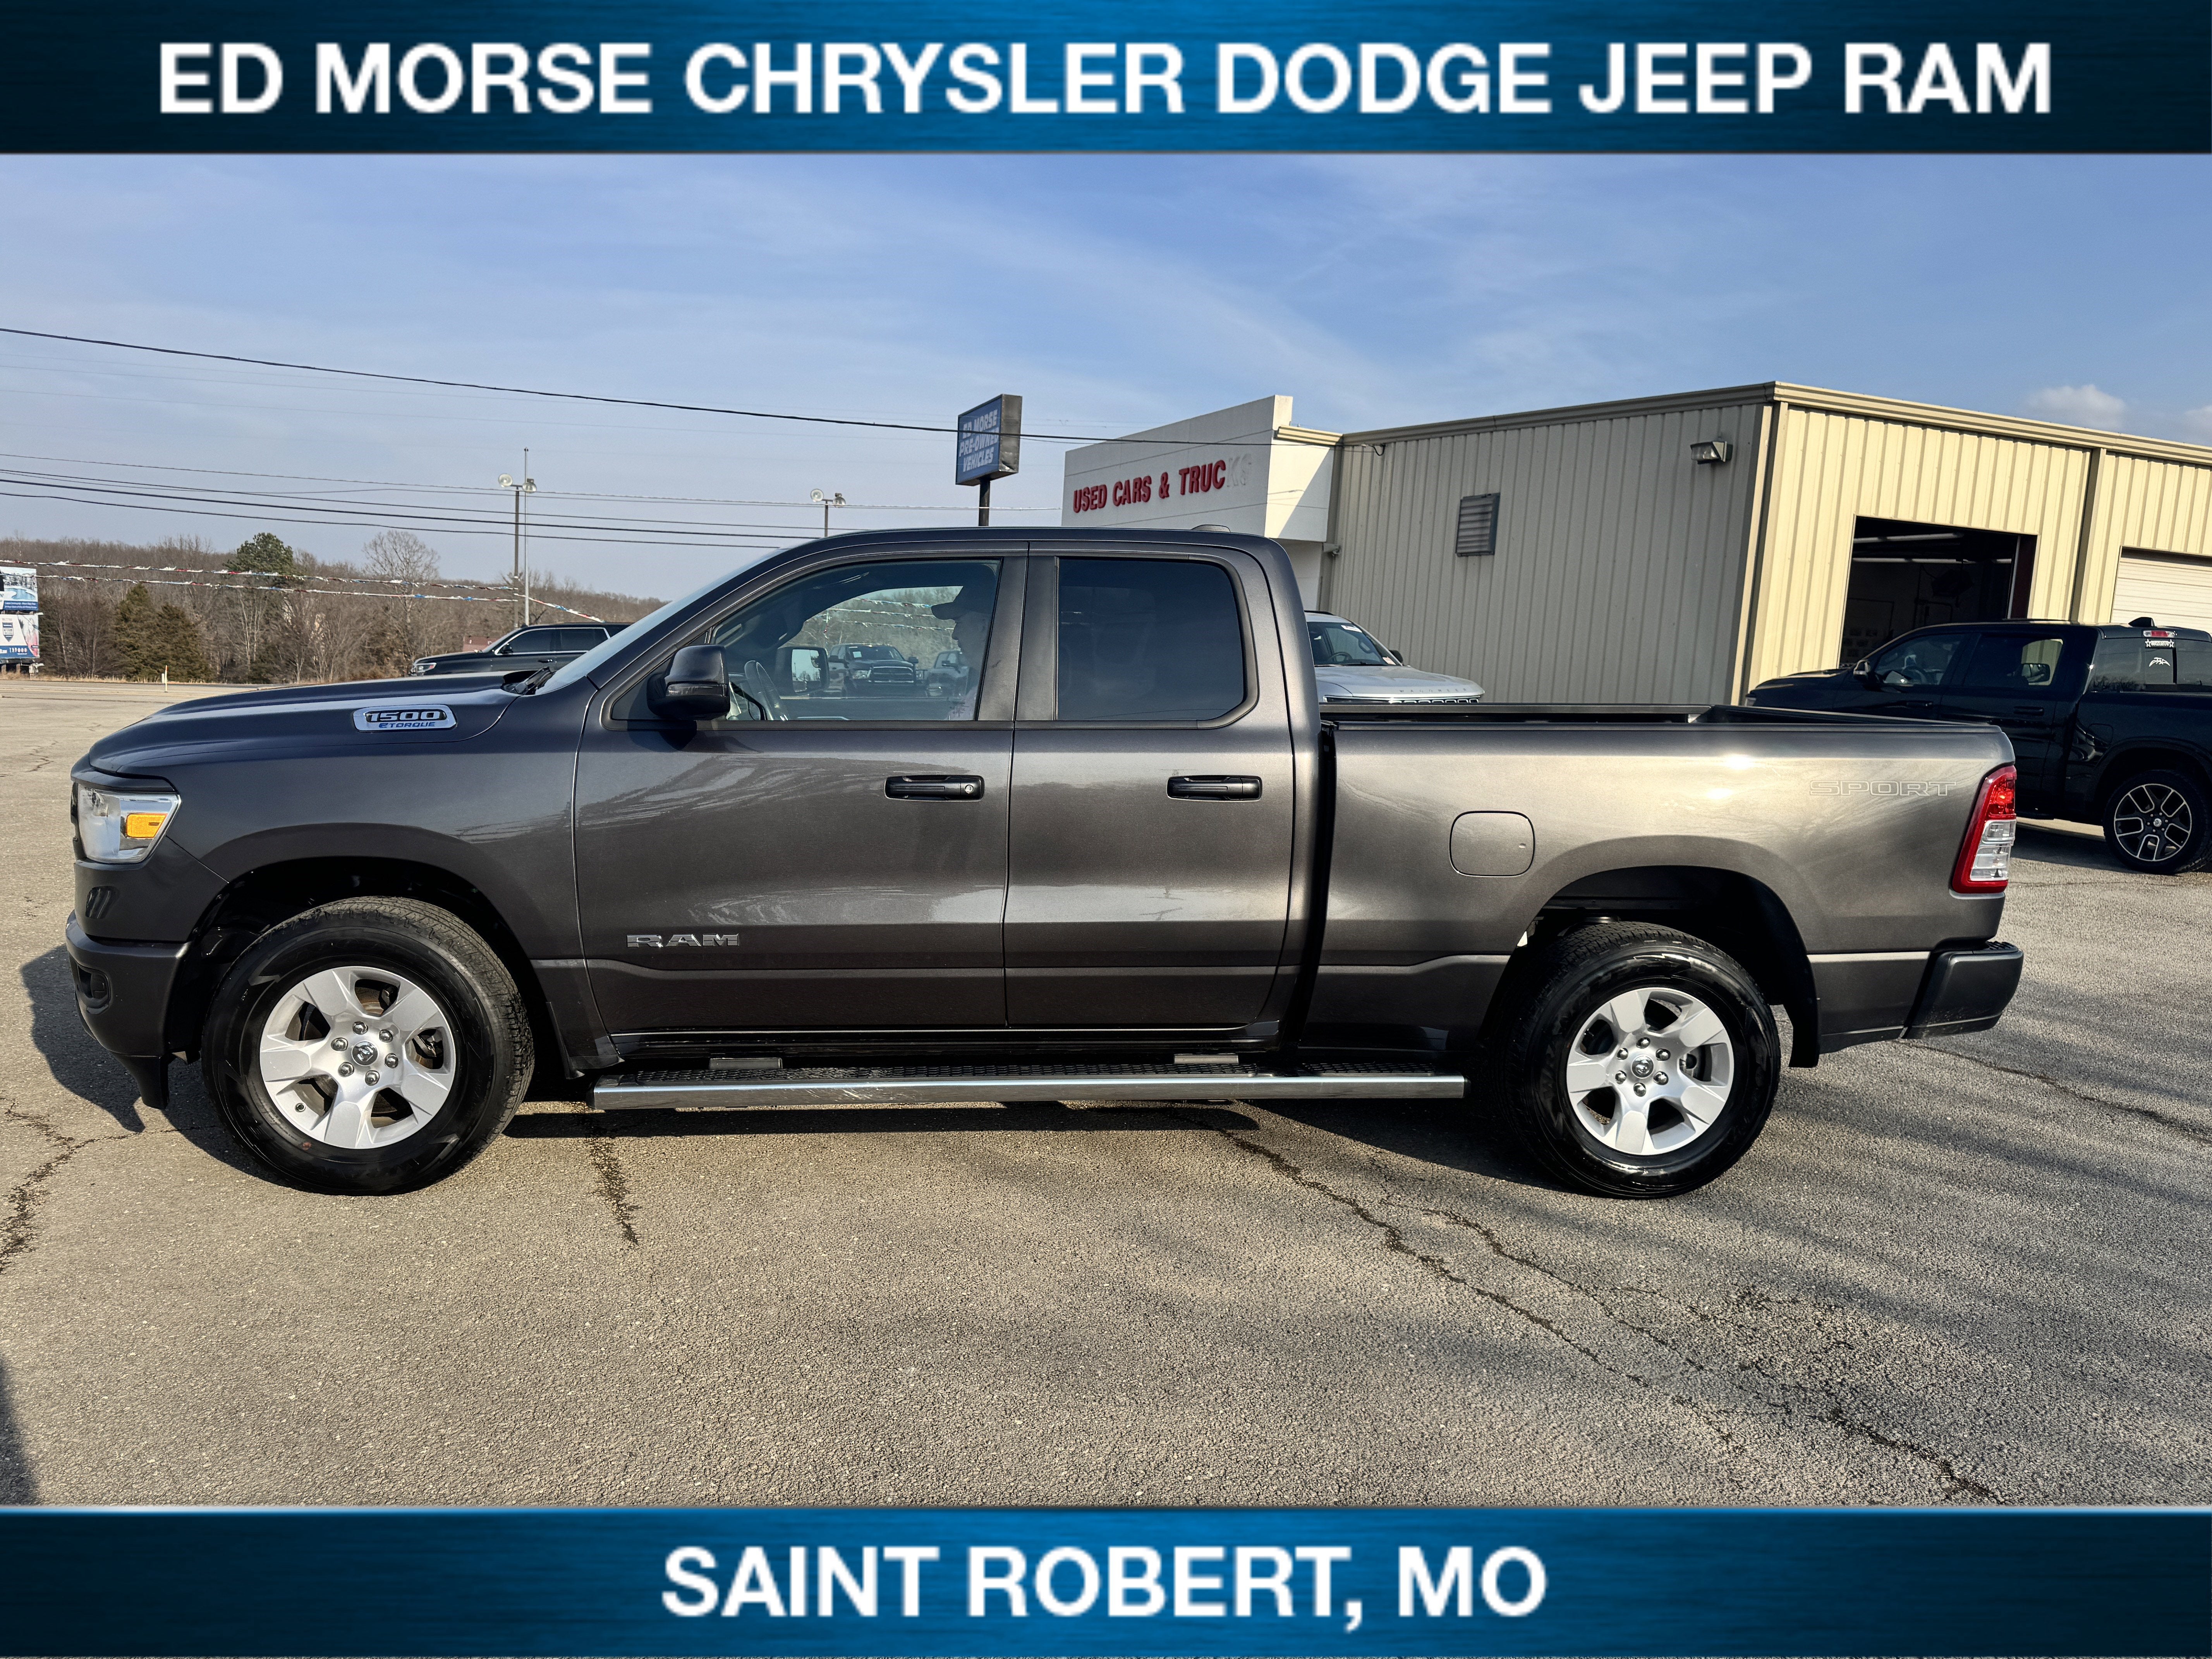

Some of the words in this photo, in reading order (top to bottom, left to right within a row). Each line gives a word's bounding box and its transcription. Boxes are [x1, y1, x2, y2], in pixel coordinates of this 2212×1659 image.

[963, 422, 972, 439] ED
[974, 409, 998, 432] MORSE
[959, 427, 999, 457] PRE-OWNED
[963, 447, 994, 472] VEHICLES
[1073, 484, 1107, 513] USED
[1113, 475, 1152, 507] CARS
[1159, 472, 1170, 499] &
[370, 711, 440, 722] 1500
[1810, 781, 1956, 796] SPORT
[627, 934, 739, 948] RAM
